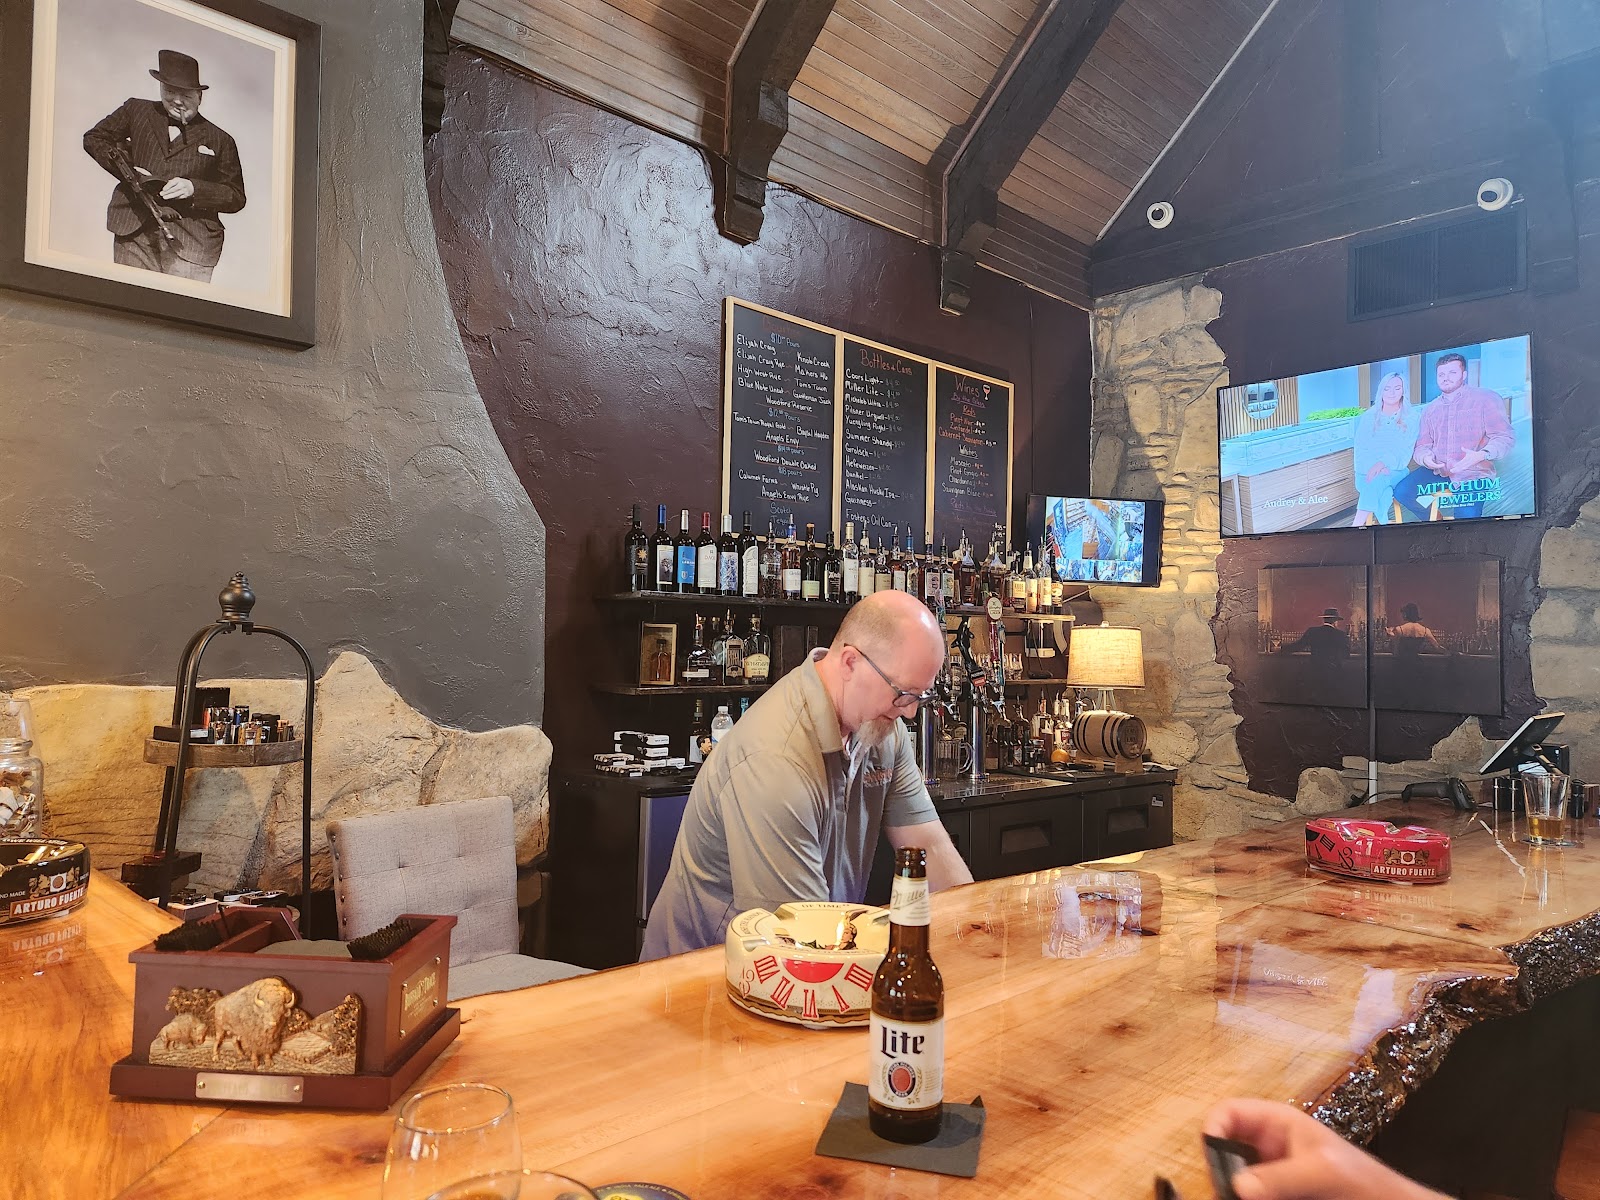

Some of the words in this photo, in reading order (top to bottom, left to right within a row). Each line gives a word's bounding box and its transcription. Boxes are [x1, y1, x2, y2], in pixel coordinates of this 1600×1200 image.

[736, 334, 758, 348] Elijah
[760, 340, 776, 355] Craig
[736, 348, 756, 362] Elijah
[758, 355, 774, 368] Craig
[860, 348, 890, 370] Bottles
[896, 360, 912, 376] Cans
[738, 364, 752, 378] High
[754, 368, 768, 378] West
[768, 372, 782, 380] Rye
[846, 368, 864, 381] Coors
[737, 377, 754, 389] Blue
[754, 381, 768, 392] Note
[812, 384, 828, 392] Town
[845, 381, 864, 392] Miller
[866, 384, 878, 396] Lite
[954, 375, 980, 398] Wines
[766, 394, 790, 408] Woodford
[790, 401, 812, 412] Reserve
[845, 394, 868, 404] Michelob
[784, 412, 800, 422] Pours
[845, 404, 864, 416] Pilsner
[846, 415, 871, 430] Yuengling
[846, 429, 870, 442] Summer
[938, 426, 961, 440] Cabernet
[786, 434, 800, 448] Envy
[754, 449, 780, 464] Woodford
[780, 458, 800, 468] Double
[950, 466, 962, 474] Pinot
[810, 482, 820, 498] Pig
[846, 479, 868, 492] Alaskan
[1416, 476, 1500, 496] MITCHUM
[1264, 498, 1296, 508] Audrey
[1298, 496, 1306, 504] &
[1308, 494, 1328, 504] Alec
[870, 514, 880, 526] Oil
[1374, 865, 1406, 876] ARTURO
[1408, 868, 1435, 876] FUENTE
[10, 890, 26, 898] MADE
[14, 897, 58, 915] ARTURO
[60, 886, 84, 906] FUENTE
[892, 889, 926, 906] Miller
[881, 1024, 925, 1060] Lite
